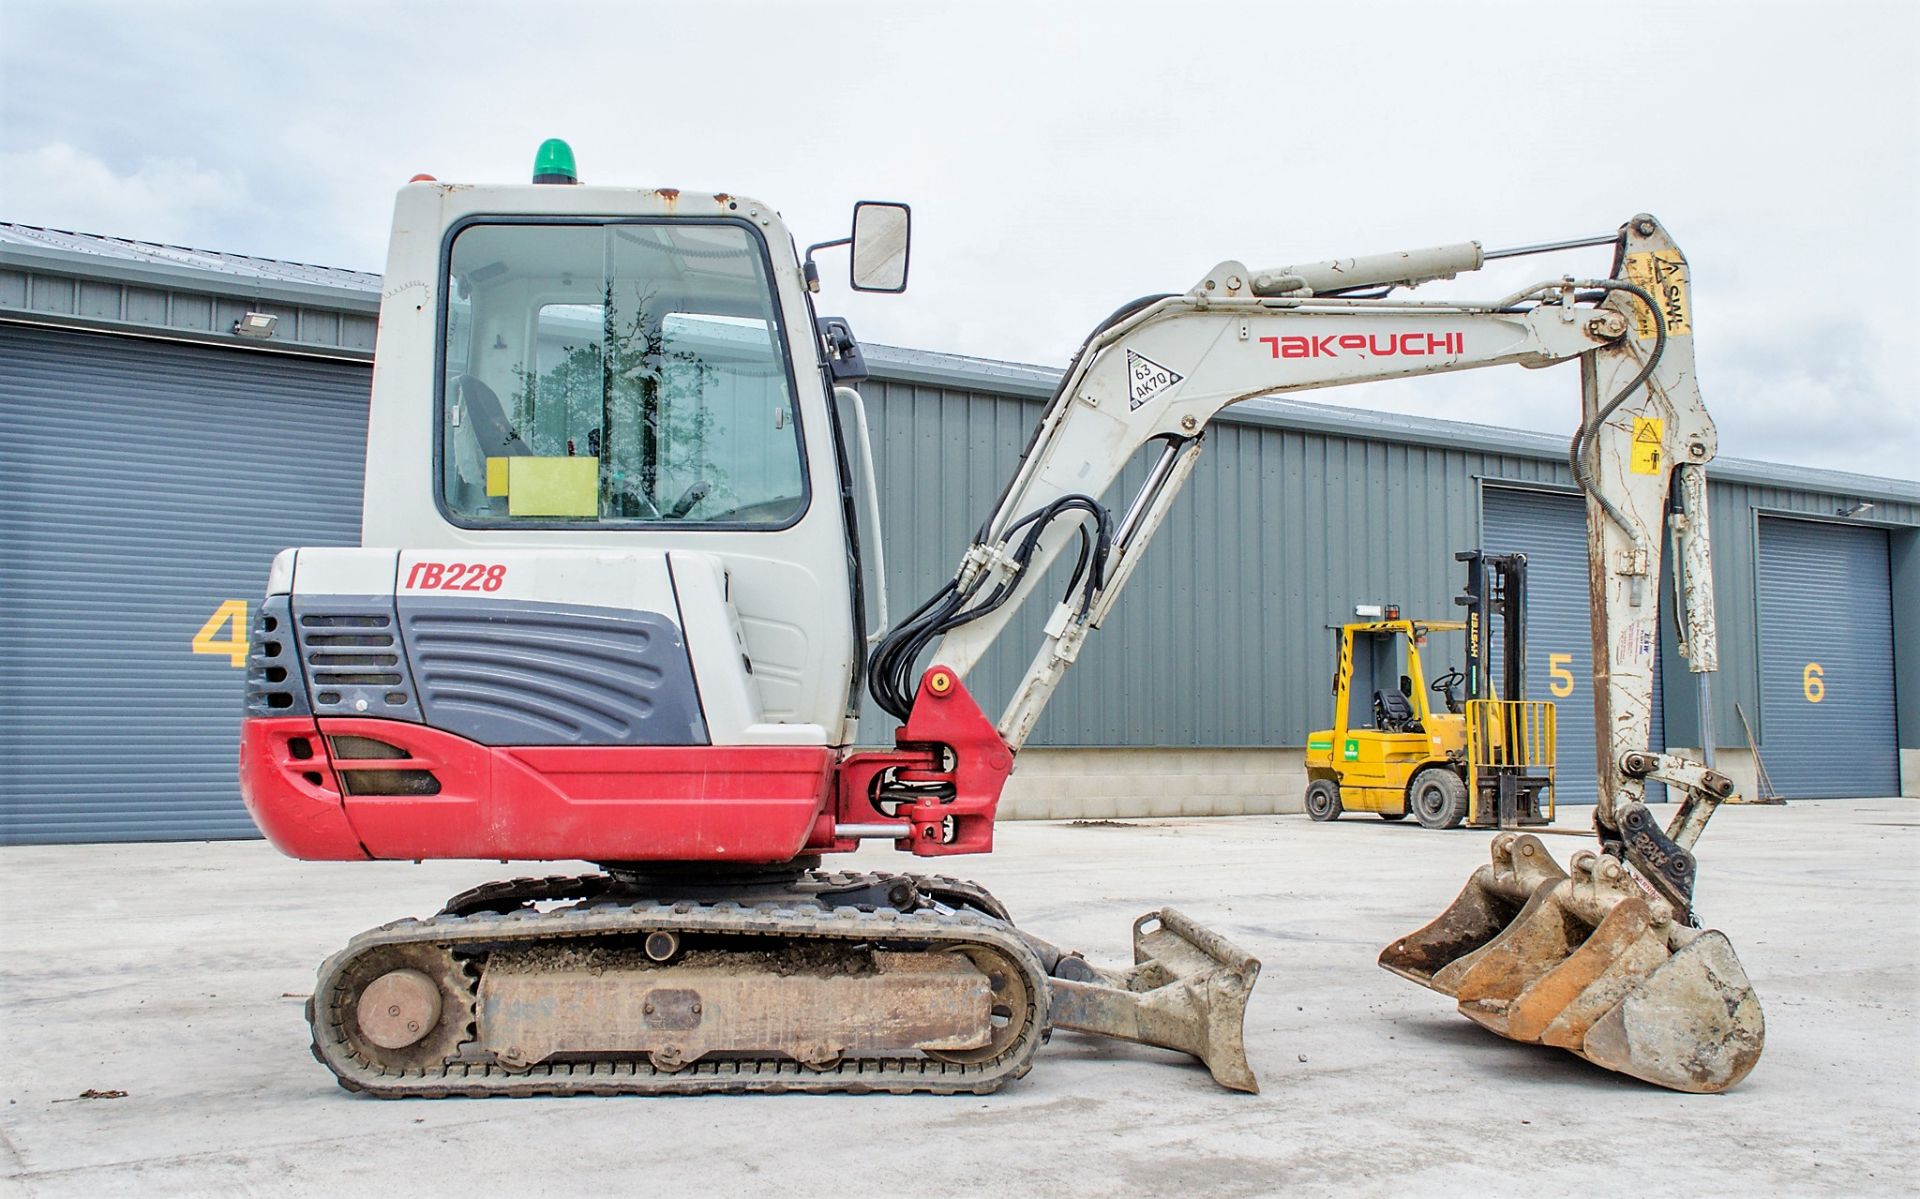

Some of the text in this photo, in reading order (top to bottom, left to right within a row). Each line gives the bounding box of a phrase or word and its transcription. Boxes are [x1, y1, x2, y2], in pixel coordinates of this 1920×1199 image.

[1135, 364, 1151, 380] 63
[1136, 372, 1167, 398] AK7Q
[405, 562, 507, 592] TB228
[192, 599, 250, 668] 4
[1471, 612, 1479, 658] HYSTER
[1550, 653, 1574, 698] 5
[1803, 662, 1825, 703] 6
